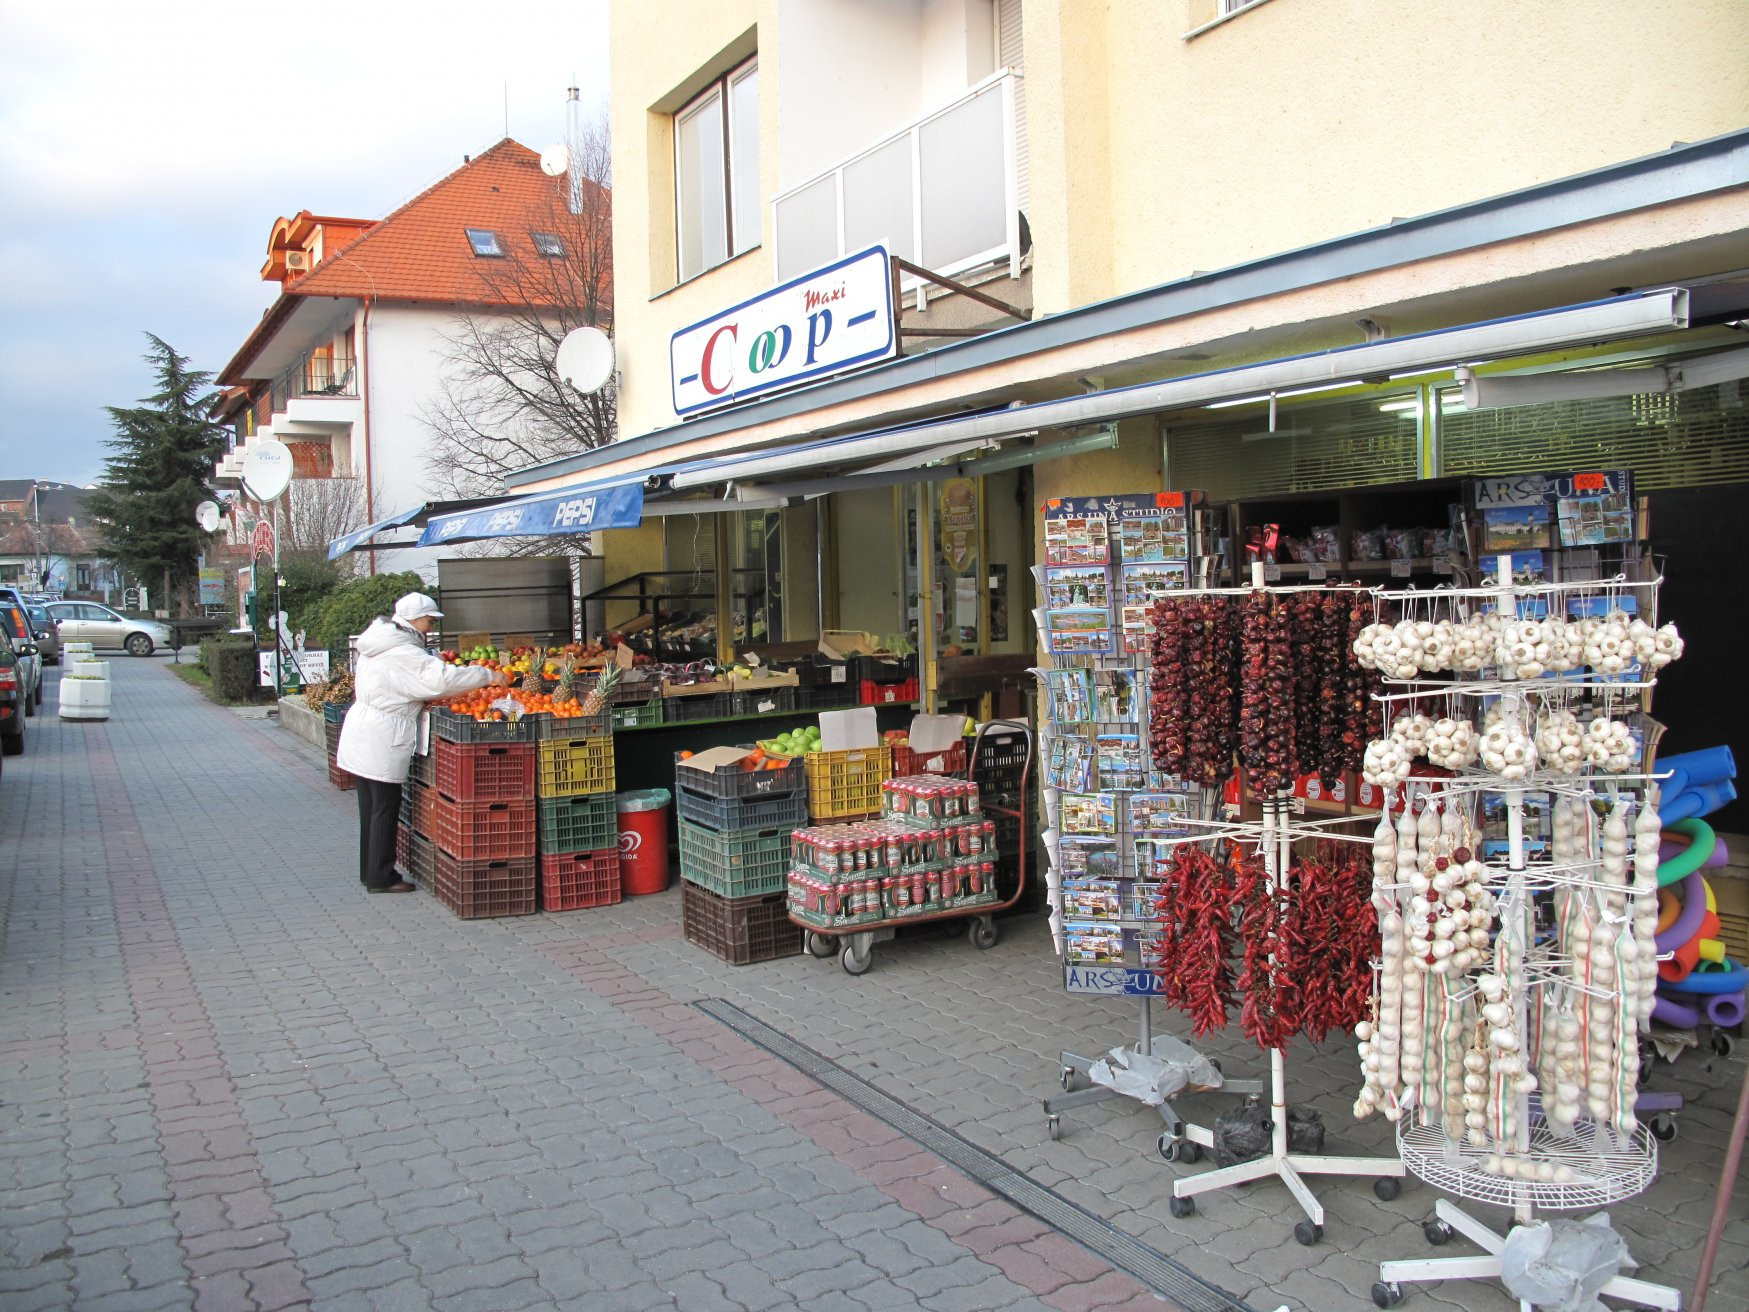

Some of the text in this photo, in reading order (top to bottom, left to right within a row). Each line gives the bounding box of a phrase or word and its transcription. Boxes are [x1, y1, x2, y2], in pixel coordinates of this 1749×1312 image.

[803, 280, 846, 313] Maxi
[701, 308, 833, 396] Coop
[1478, 475, 1617, 503] ARS UA
[1617, 470, 1626, 494] STUD
[486, 508, 525, 530] PEPSI
[553, 497, 597, 528] PEPSI
[1069, 969, 1166, 991] ARS UN
